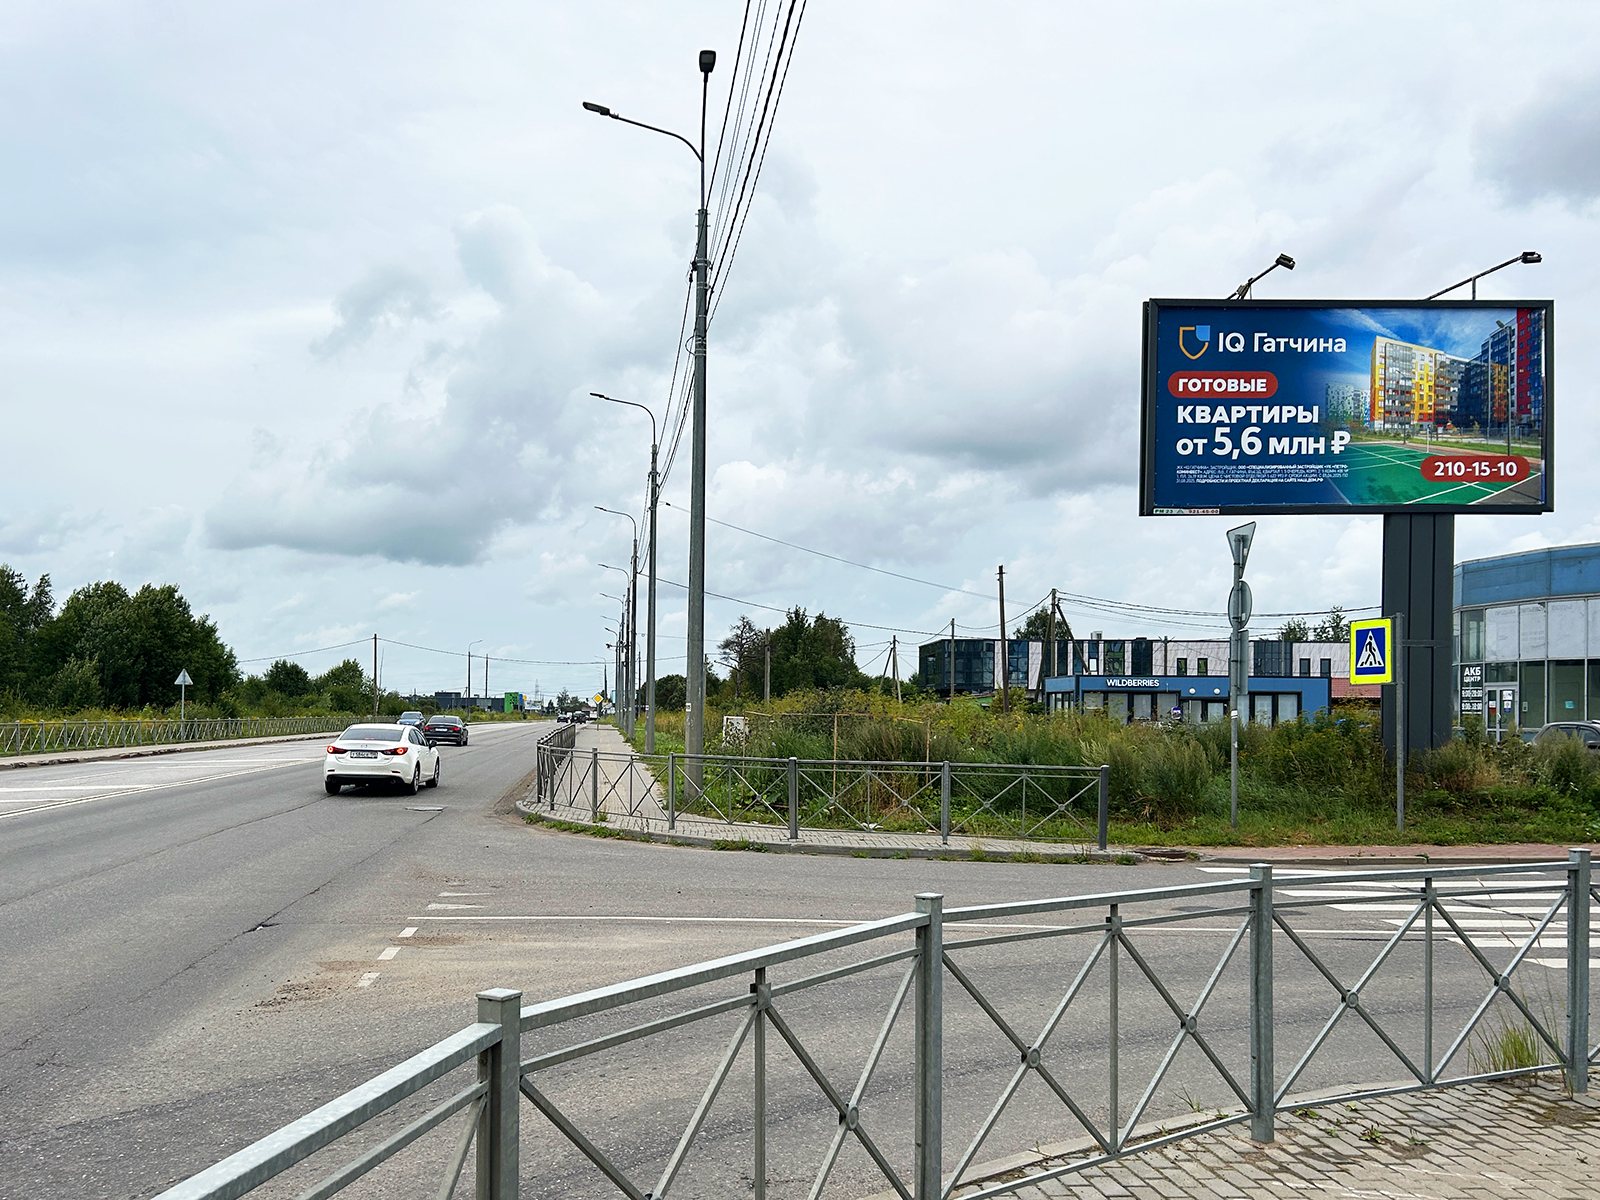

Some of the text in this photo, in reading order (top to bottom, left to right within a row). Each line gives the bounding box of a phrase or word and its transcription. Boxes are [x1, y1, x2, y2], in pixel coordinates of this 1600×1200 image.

[1218, 332, 1347, 353] IQ Гатчина
[1178, 378, 1267, 392] ГОТОВЫЕ
[1177, 405, 1319, 423] КВАРТИРЫ
[1212, 426, 1263, 460] 5,6
[1434, 461, 1518, 477] 210-15-10
[1464, 666, 1481, 676] АКБ
[1106, 679, 1160, 687] WILDBERRIES
